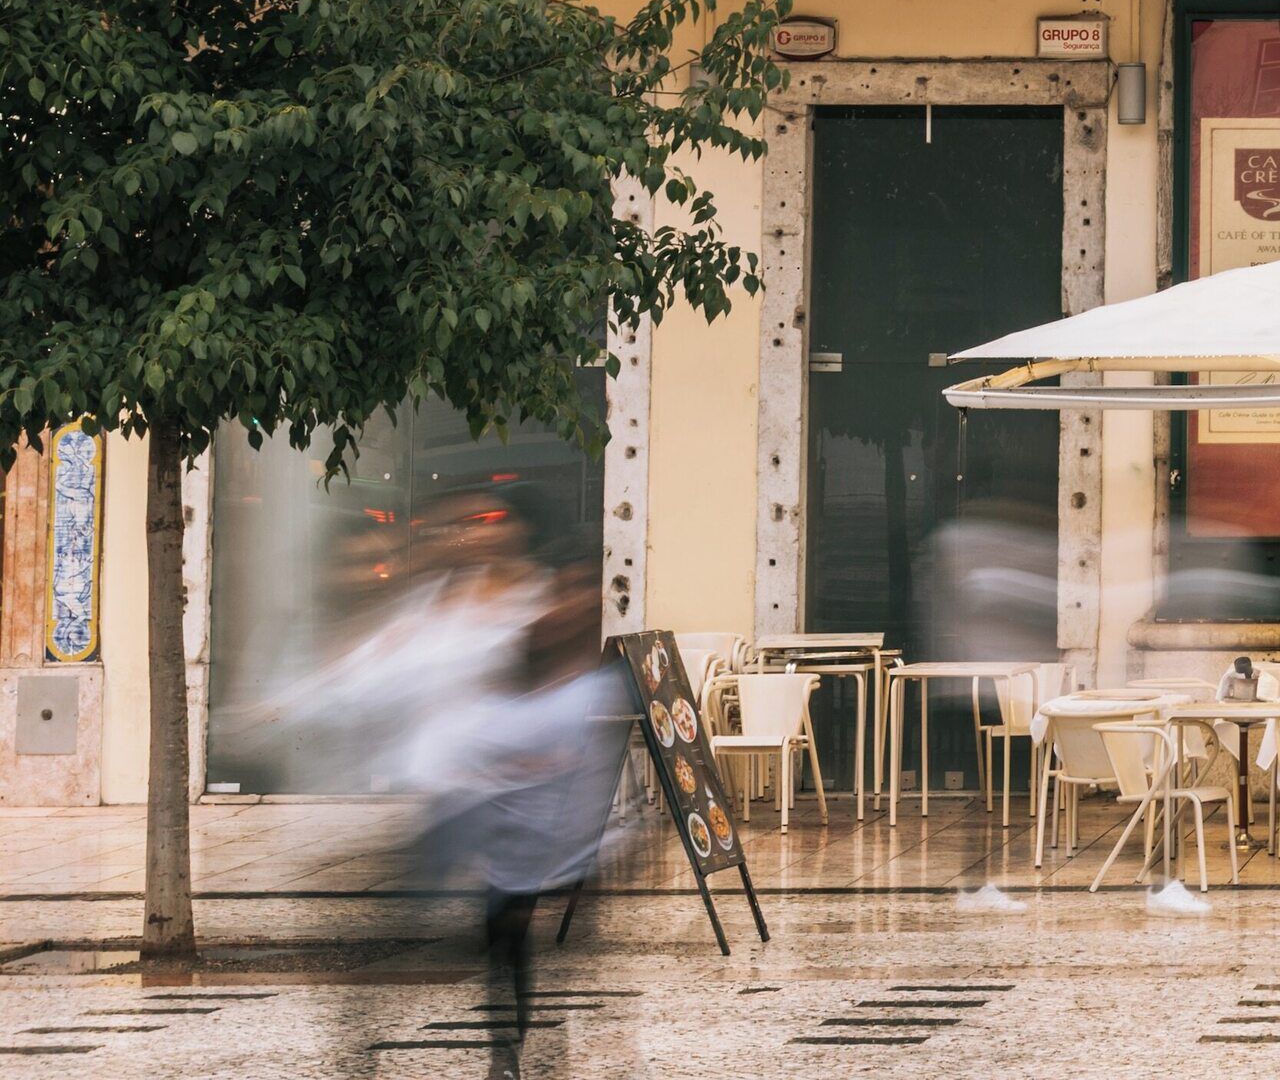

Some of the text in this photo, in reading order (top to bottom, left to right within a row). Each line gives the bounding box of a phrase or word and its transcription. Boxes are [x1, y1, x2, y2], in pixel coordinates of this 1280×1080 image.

[1042, 29, 1100, 41] GRUPO 8
[1063, 41, 1100, 51] Segurança
[1217, 230, 1247, 240] CAFÉ
[1250, 231, 1265, 241] OF
